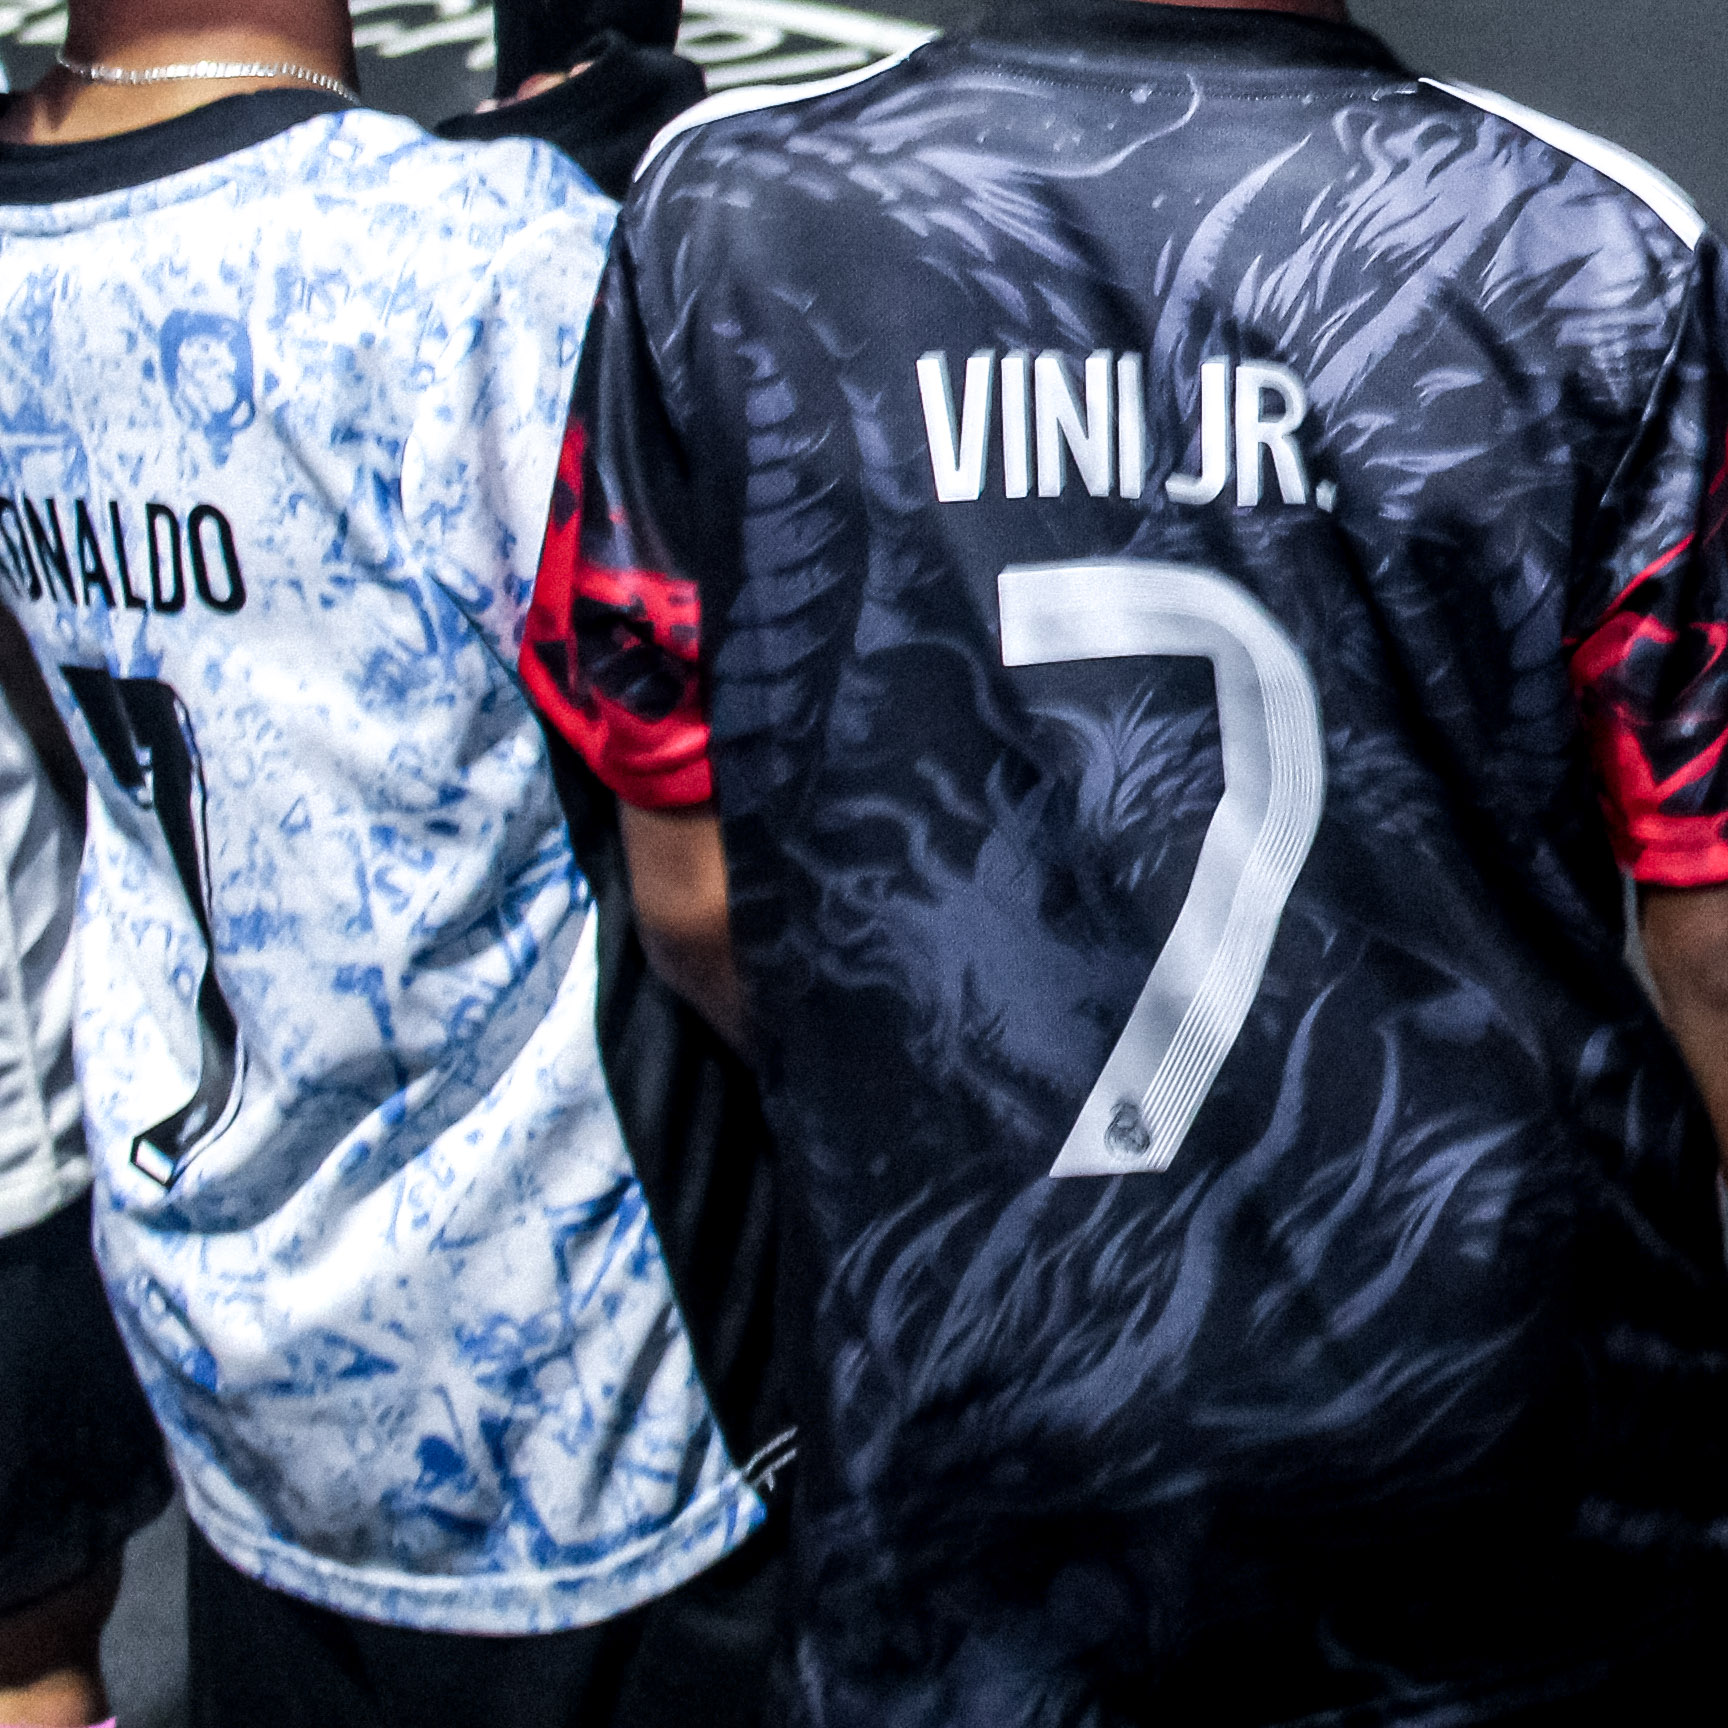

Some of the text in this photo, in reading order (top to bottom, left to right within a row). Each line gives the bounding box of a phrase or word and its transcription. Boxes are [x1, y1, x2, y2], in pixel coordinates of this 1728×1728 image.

[0, 494, 247, 615] ONALDO
[916, 347, 1339, 509] VINI JR.
[60, 665, 248, 1189] 7
[998, 557, 1326, 1179] 7
